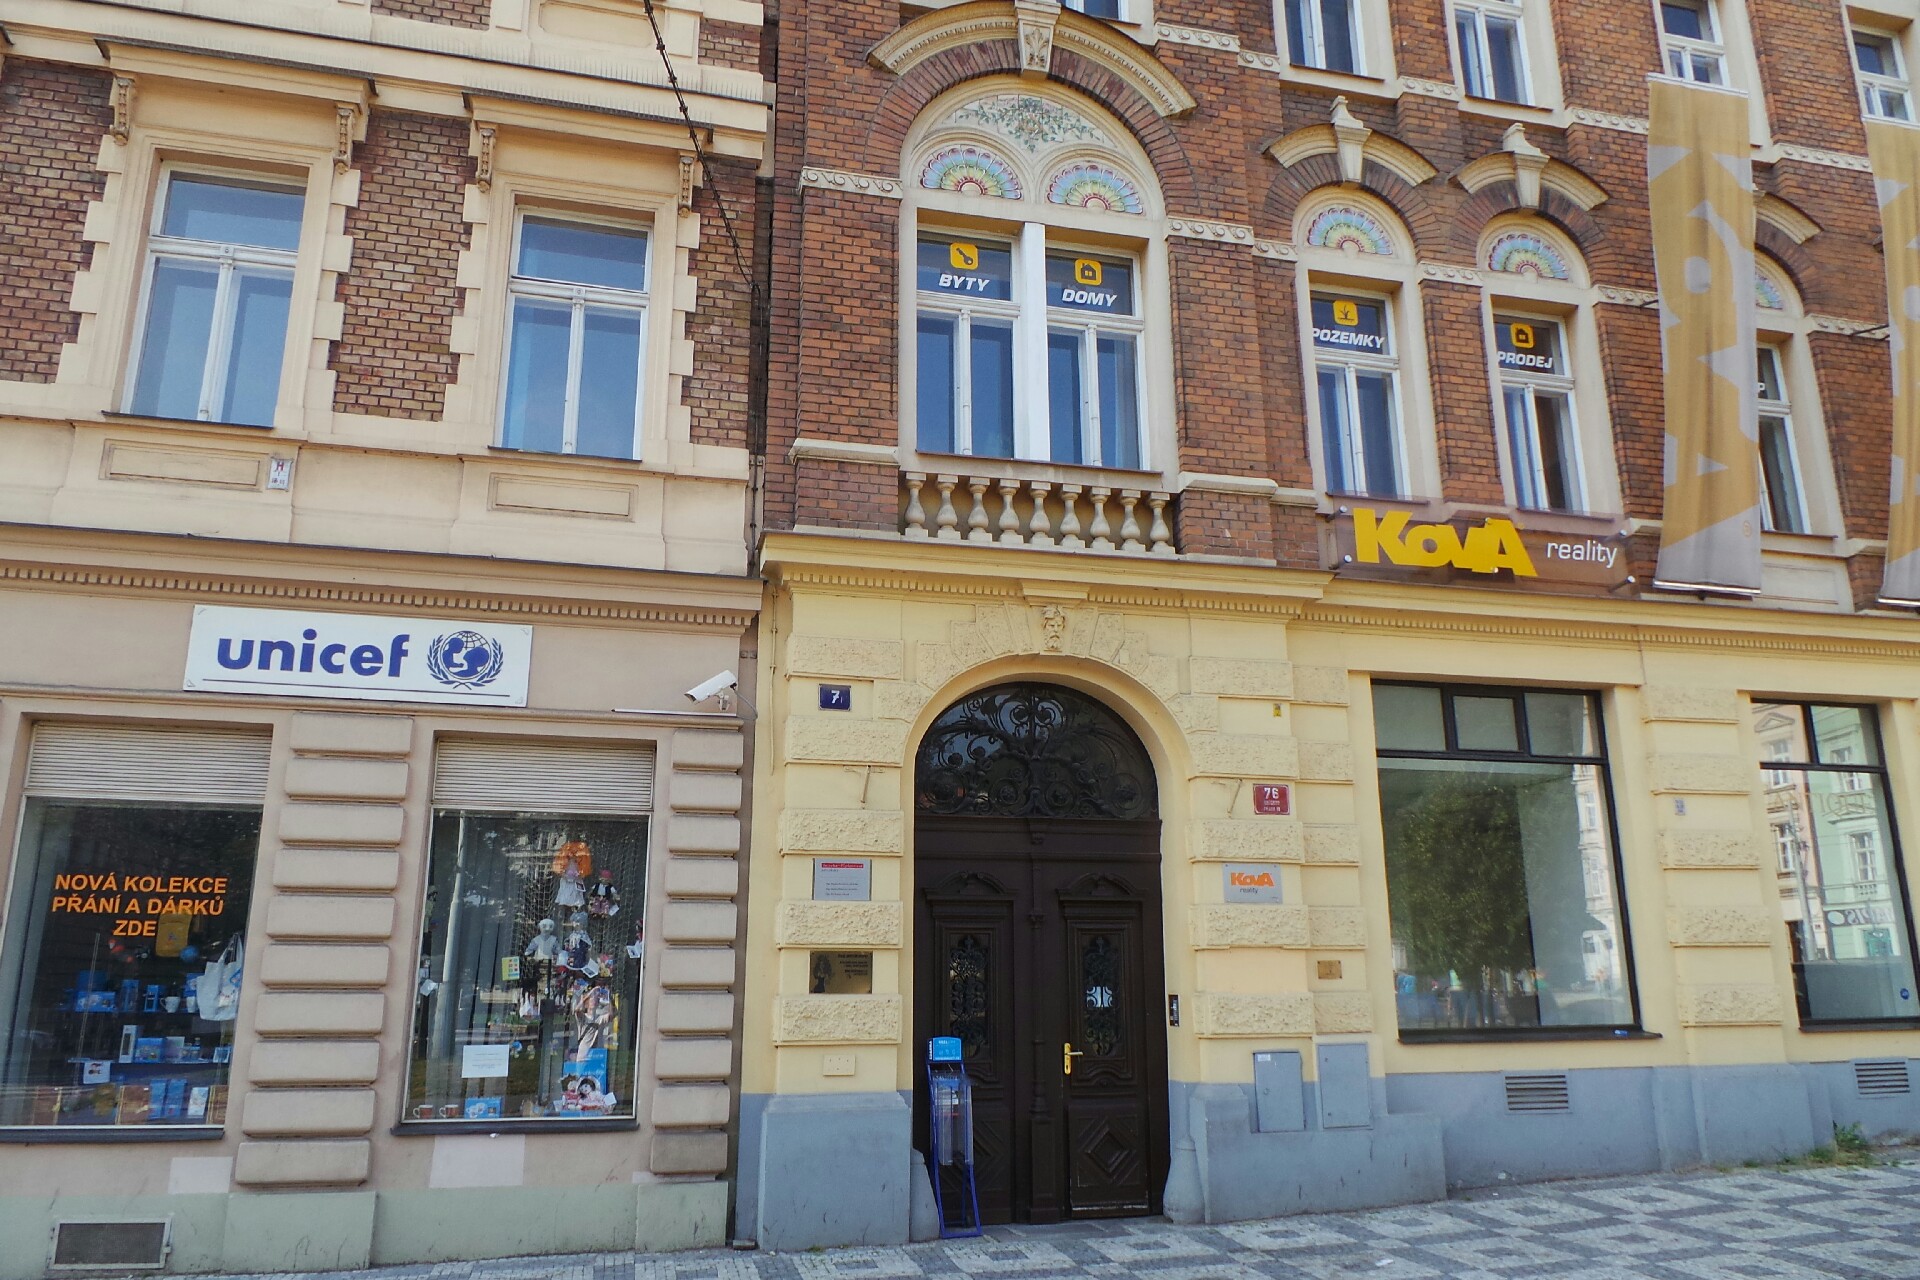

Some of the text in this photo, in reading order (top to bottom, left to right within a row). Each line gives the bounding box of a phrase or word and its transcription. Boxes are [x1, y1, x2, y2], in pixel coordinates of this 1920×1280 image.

[939, 273, 990, 292] BYTY
[1062, 288, 1118, 307] DOMY
[1312, 327, 1386, 349] POZEMKY
[1498, 350, 1553, 369] PRODEJ
[1547, 539, 1618, 569] reality
[217, 628, 410, 677] unicef
[1263, 787, 1279, 800] 76
[54, 871, 228, 894] NOVÁ KOLEKCE
[51, 893, 224, 916] PŘÁNÍ A DÁRKŮ
[112, 919, 158, 937] ZDE
